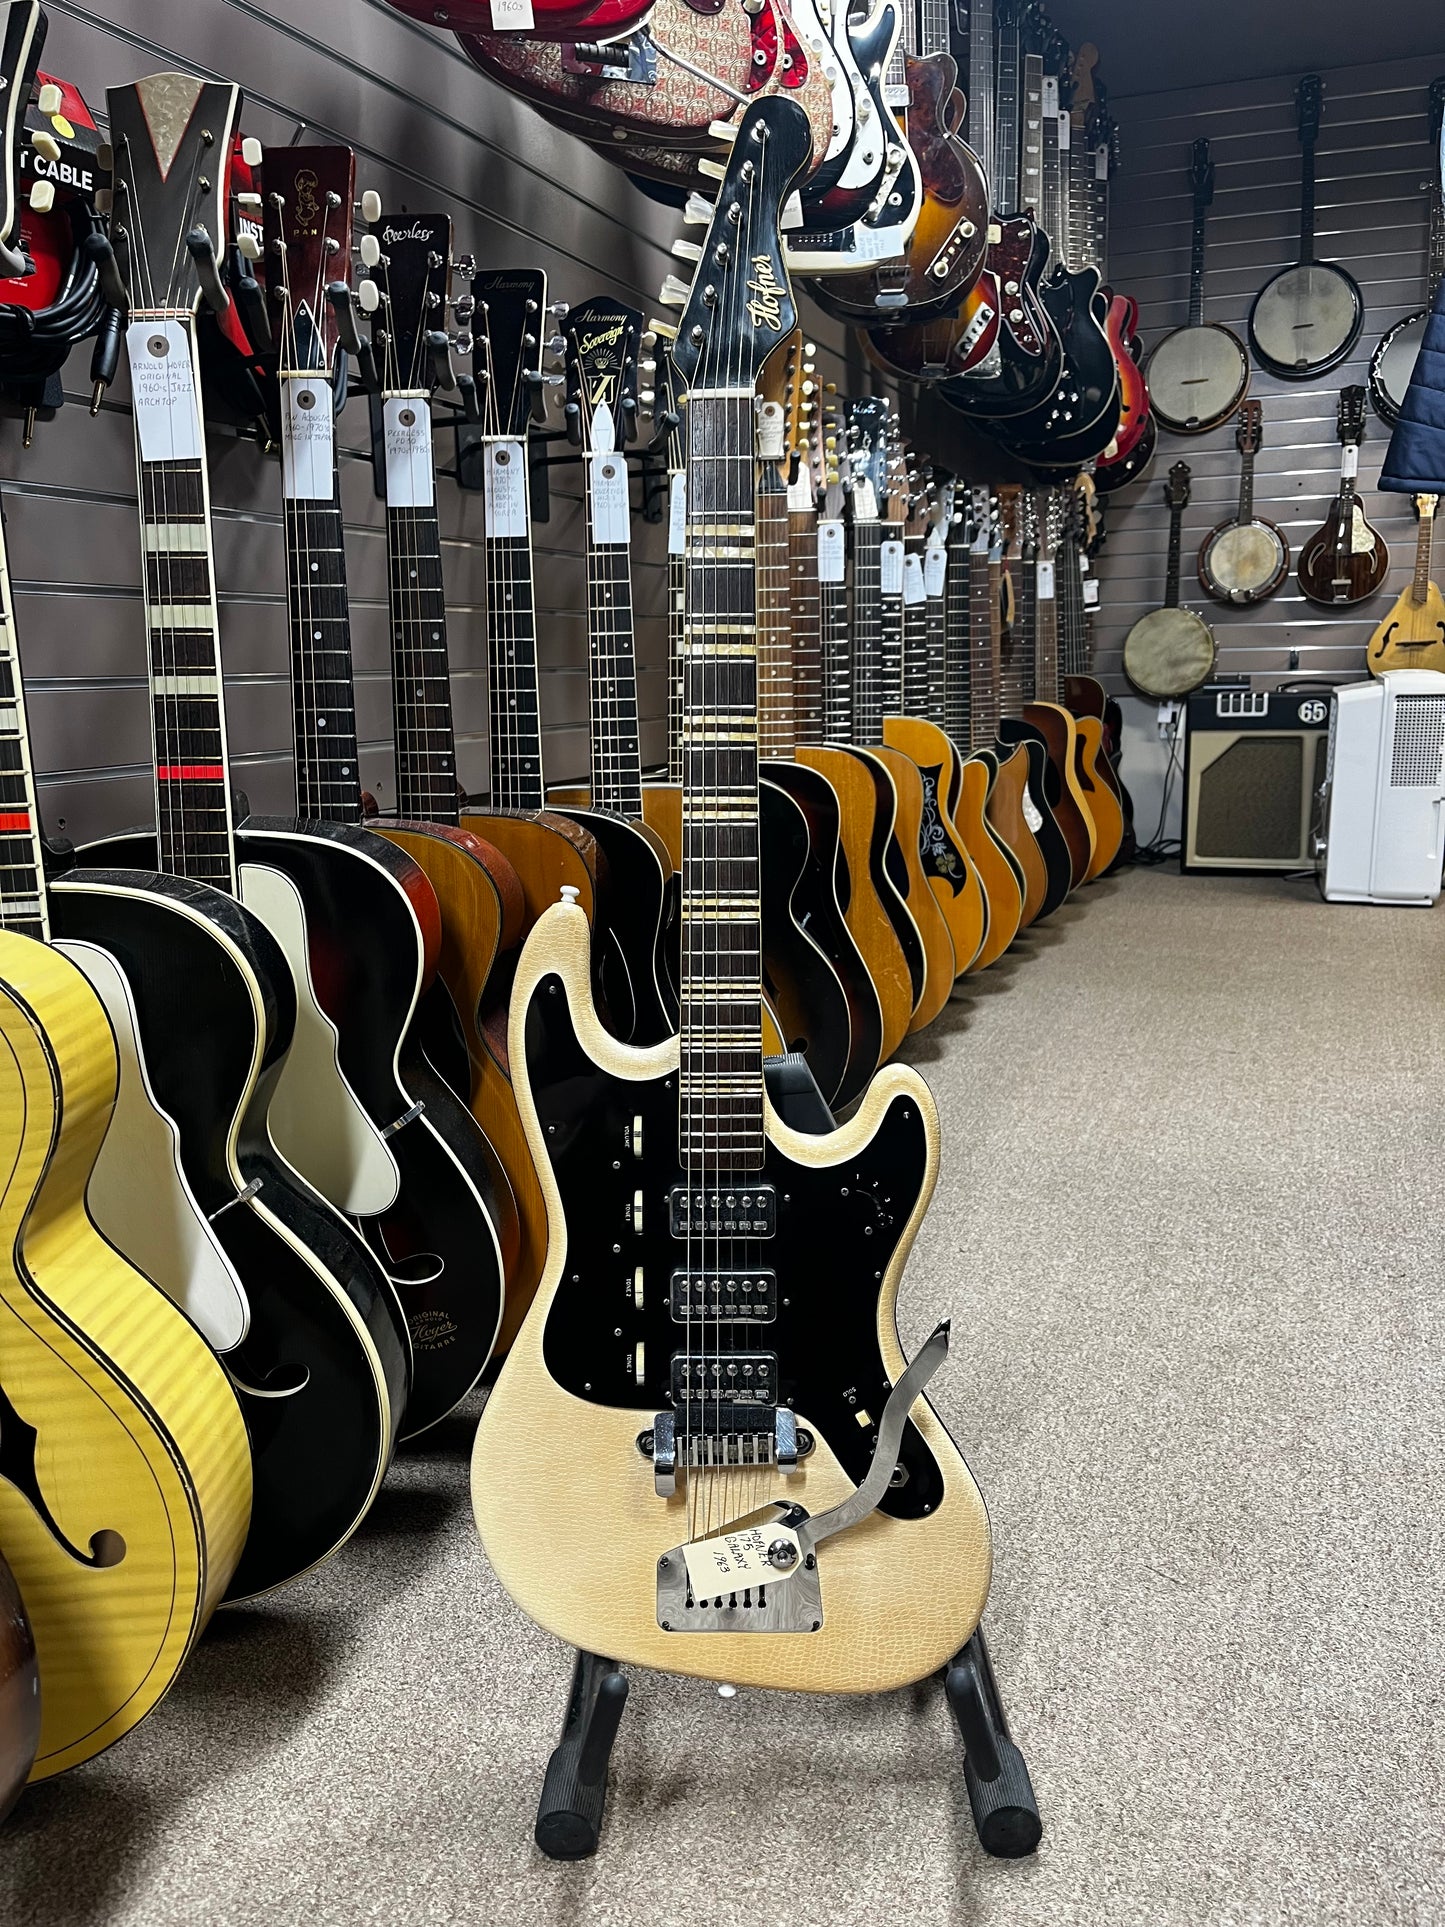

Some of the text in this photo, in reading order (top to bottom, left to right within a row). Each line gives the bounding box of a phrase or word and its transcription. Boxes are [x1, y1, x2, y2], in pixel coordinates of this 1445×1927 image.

[33, 154, 93, 192] CABLE
[293, 228, 317, 236] PAN
[382, 220, 435, 245] Peerless
[484, 276, 535, 292] Harmony
[746, 254, 787, 331] Hofner
[575, 309, 628, 324] Harmony
[579, 325, 624, 354] Sovereign
[132, 362, 164, 371] ARNOLD
[170, 382, 193, 393] JAZZ
[1301, 702, 1324, 722] 65
[407, 1310, 450, 1325] ORIGINAL
[412, 1335, 456, 1350] GITARRE
[737, 1533, 752, 1551] 175
[713, 1551, 731, 1573] 1963
[724, 1536, 752, 1570] GALAXY
